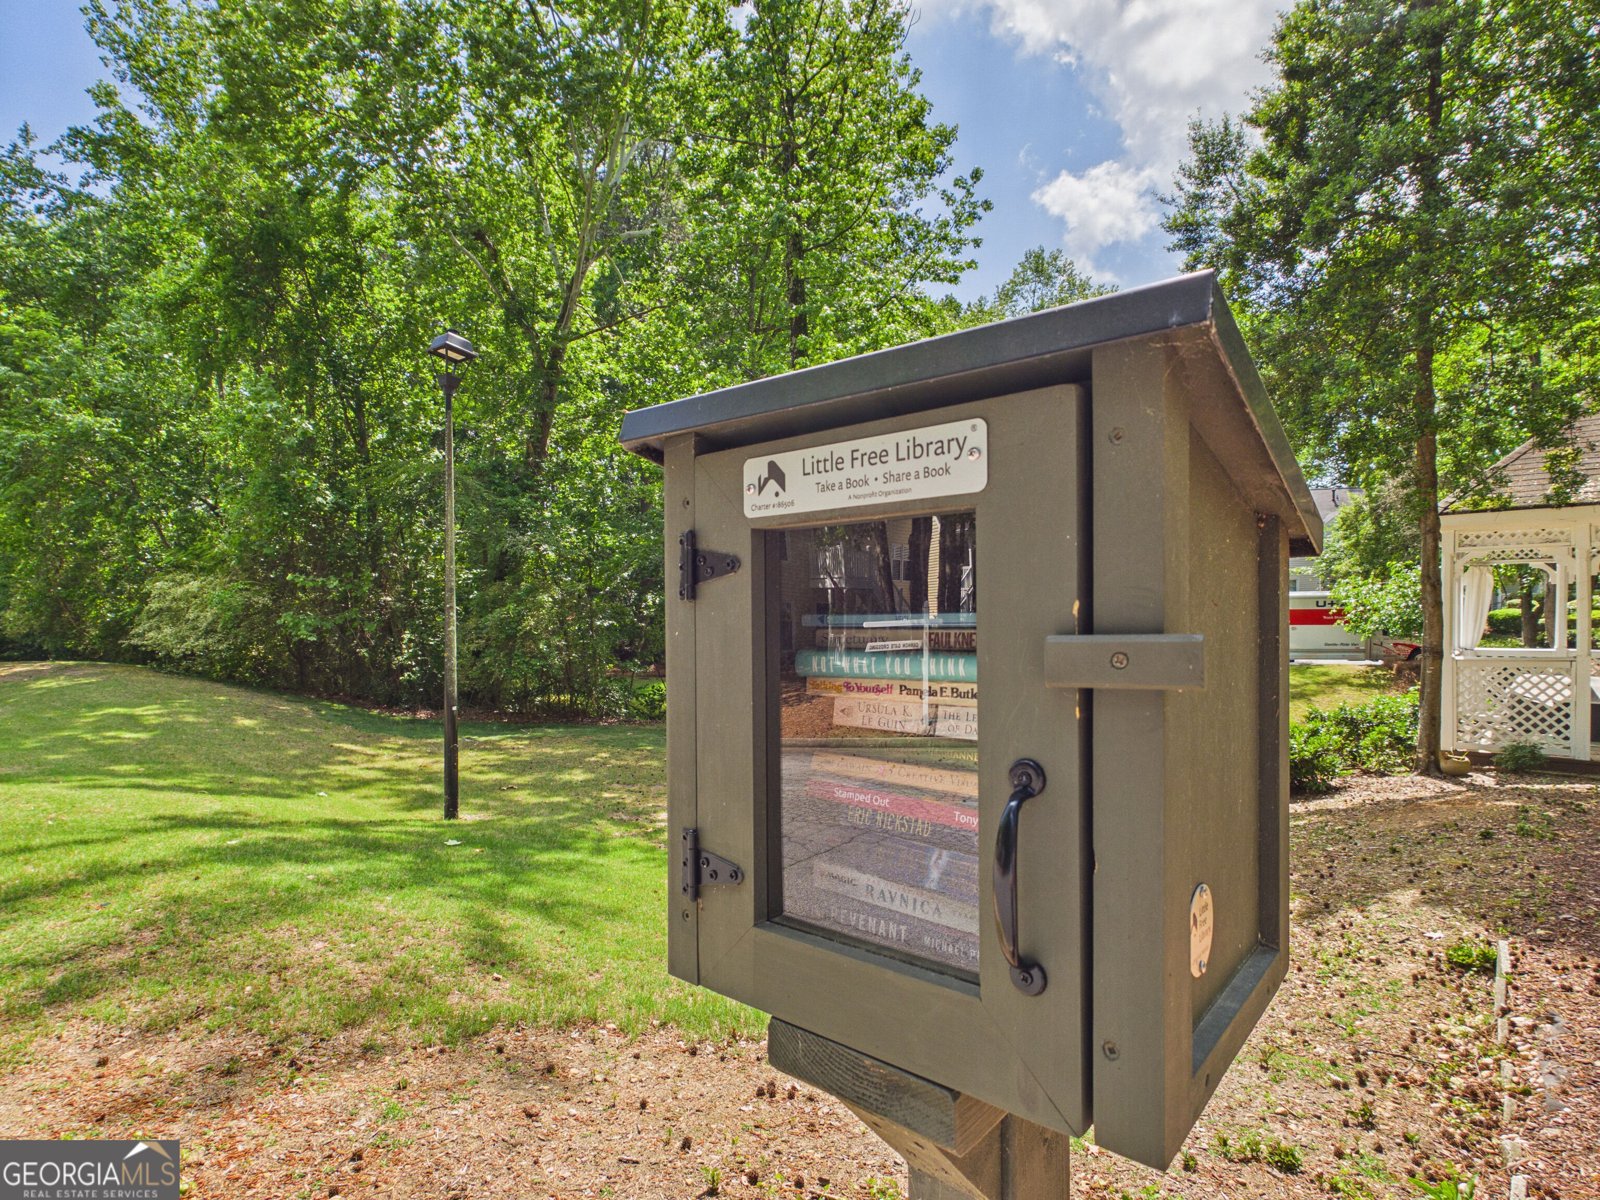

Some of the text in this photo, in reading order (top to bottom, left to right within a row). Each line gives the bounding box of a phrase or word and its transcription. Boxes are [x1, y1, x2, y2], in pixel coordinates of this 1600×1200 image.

[802, 436, 967, 476] Little Free Library
[816, 463, 951, 494] Take a Book Share a Book
[878, 488, 912, 498] Organization
[751, 502, 771, 512] Charter
[812, 656, 834, 673] NOT
[843, 656, 876, 674] WHAT
[886, 656, 910, 675] YOU
[858, 702, 897, 716] URSULA
[942, 710, 960, 720] THE
[861, 714, 905, 730] LE GUIN
[834, 787, 890, 808] Stamped Out
[848, 805, 932, 838] ERIC RICKSTAD
[954, 810, 978, 825] Tony
[865, 884, 942, 917] RAVNICA
[923, 935, 965, 956] MICHAEL
